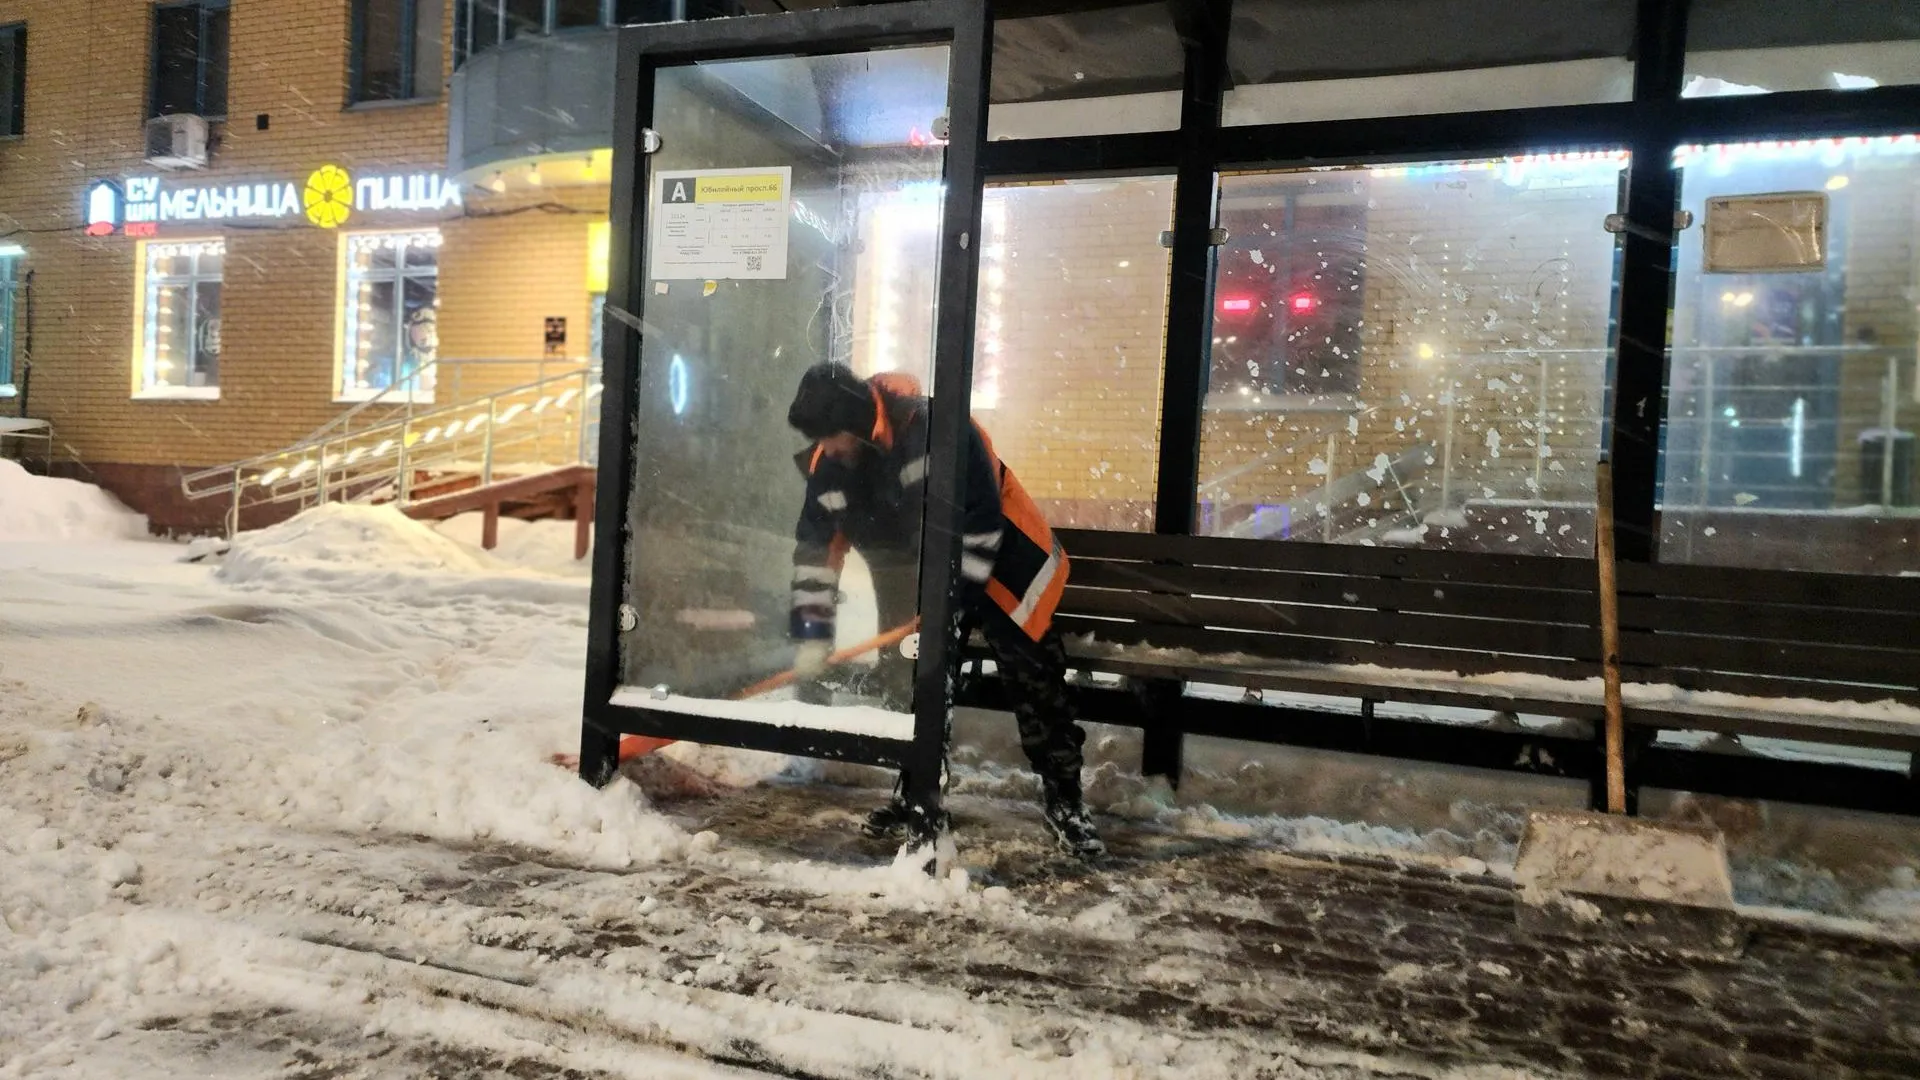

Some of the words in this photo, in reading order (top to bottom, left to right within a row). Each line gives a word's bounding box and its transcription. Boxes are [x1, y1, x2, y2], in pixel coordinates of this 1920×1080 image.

[126, 177, 159, 201] СУ
[356, 173, 462, 211] ПИЦЦА
[701, 185, 744, 194] Юбилейный
[125, 203, 158, 221] ШИ
[159, 182, 300, 222] МЕЛЬНИЦА
